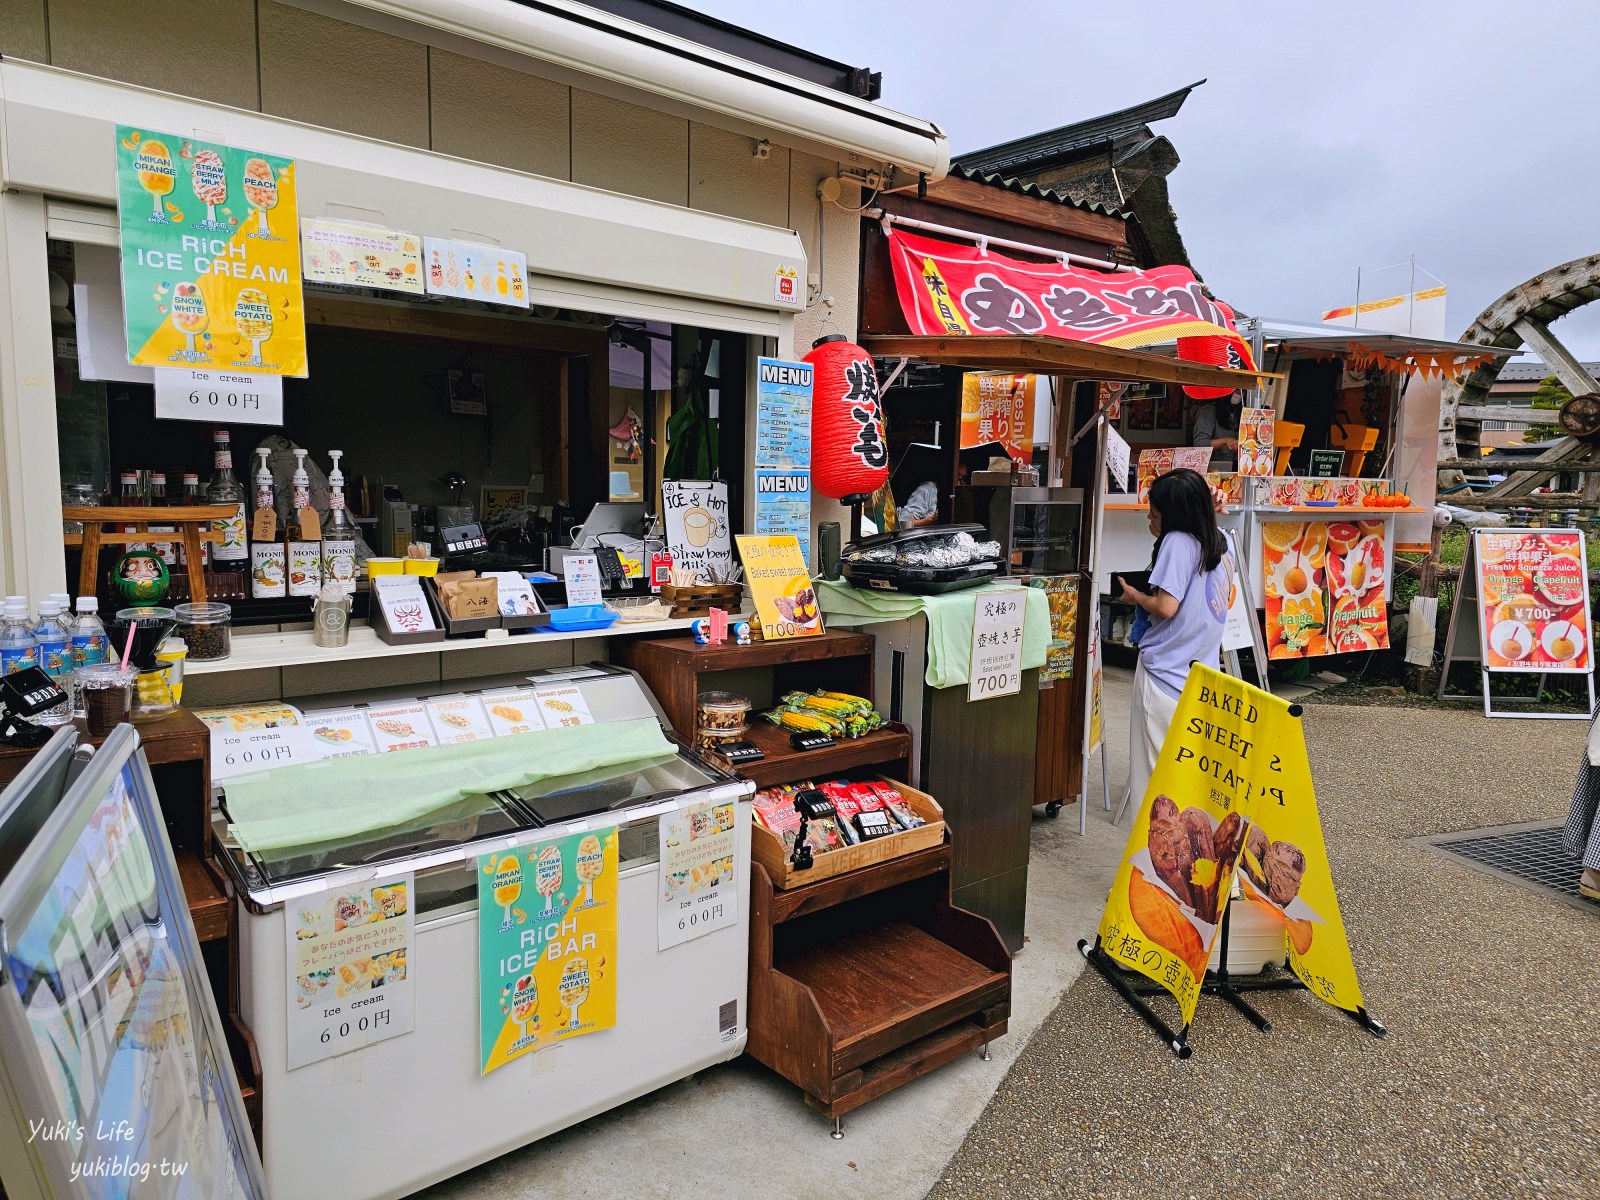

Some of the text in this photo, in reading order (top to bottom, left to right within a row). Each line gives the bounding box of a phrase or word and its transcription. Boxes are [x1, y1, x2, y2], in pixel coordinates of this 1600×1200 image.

[139, 154, 171, 167] MIKAN
[134, 162, 177, 176] ORANGE
[195, 163, 224, 173] STRAW
[195, 170, 223, 180] BERRY
[200, 178, 220, 186] MILK
[244, 177, 276, 189] PEACH
[137, 248, 289, 284] ICE CREAM
[174, 296, 203, 306] SNOW
[173, 304, 204, 314] WHITE
[237, 303, 269, 313] SWEET
[234, 311, 273, 321] POTATO
[192, 371, 252, 384] Ice cream
[761, 364, 812, 387] MENU
[1010, 378, 1028, 450] Freshly
[758, 475, 808, 493] MENU
[666, 494, 688, 509] ICE
[707, 494, 728, 510] HOT
[1486, 538, 1573, 552] 生搾りジュース
[751, 566, 806, 578] Baked sweet potato
[1486, 564, 1577, 572] Freshly Squeeze Juice
[1488, 575, 1581, 585] Orange Grapefruit
[985, 601, 1016, 617] 究極の
[1333, 607, 1379, 623] Grapefruit
[1277, 612, 1313, 627] Orange
[536, 688, 578, 698] Sweet potato
[436, 700, 469, 711] PEACH
[1198, 686, 1258, 724] BAKED
[369, 706, 424, 719] STRAWBERRY MILK
[305, 713, 363, 727] SNOW WHITE
[250, 733, 281, 742] cream
[1186, 717, 1253, 760] SWEET
[716, 810, 729, 819] SOLD
[693, 817, 707, 826] SOLD
[538, 857, 561, 868] STRAW
[577, 852, 603, 864] PEACH
[495, 869, 520, 881] MIKAN
[538, 864, 560, 874] BERRY
[541, 870, 557, 879] MILK
[491, 875, 524, 890] ORANGE
[381, 895, 397, 906] SOLD
[680, 892, 718, 909] Ice cream
[341, 904, 357, 914] SOLD
[311, 926, 397, 954] あなたのお気に入りの
[500, 932, 597, 977] ICE BAR
[562, 971, 587, 983] SWEET
[559, 977, 590, 991] POTATO
[514, 986, 536, 999] SNOW
[323, 994, 384, 1018] Ice cream
[513, 993, 536, 1007] WHITE
